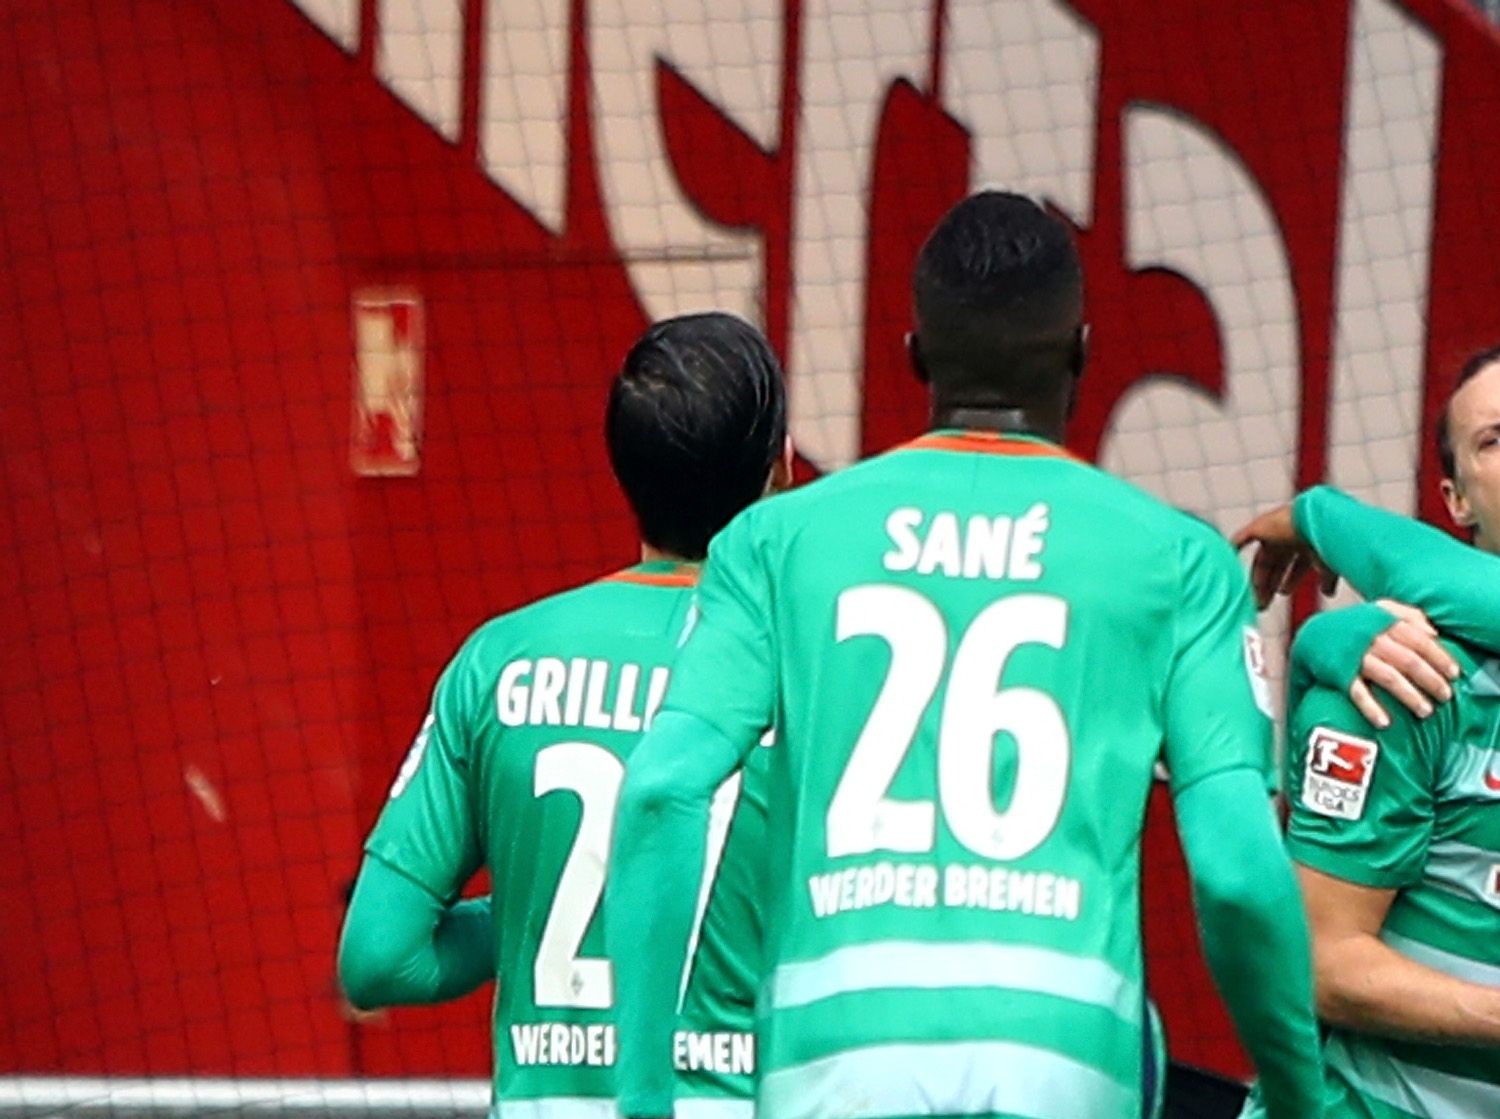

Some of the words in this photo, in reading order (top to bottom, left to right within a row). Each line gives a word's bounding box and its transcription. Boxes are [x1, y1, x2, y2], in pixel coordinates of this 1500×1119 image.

[884, 503, 1049, 579] SANÉ
[496, 657, 669, 732] GRILLI
[827, 584, 1070, 860] 26
[809, 862, 938, 918] WERDER
[943, 863, 1081, 920] BREMEN
[673, 1031, 754, 1074] EMEN
